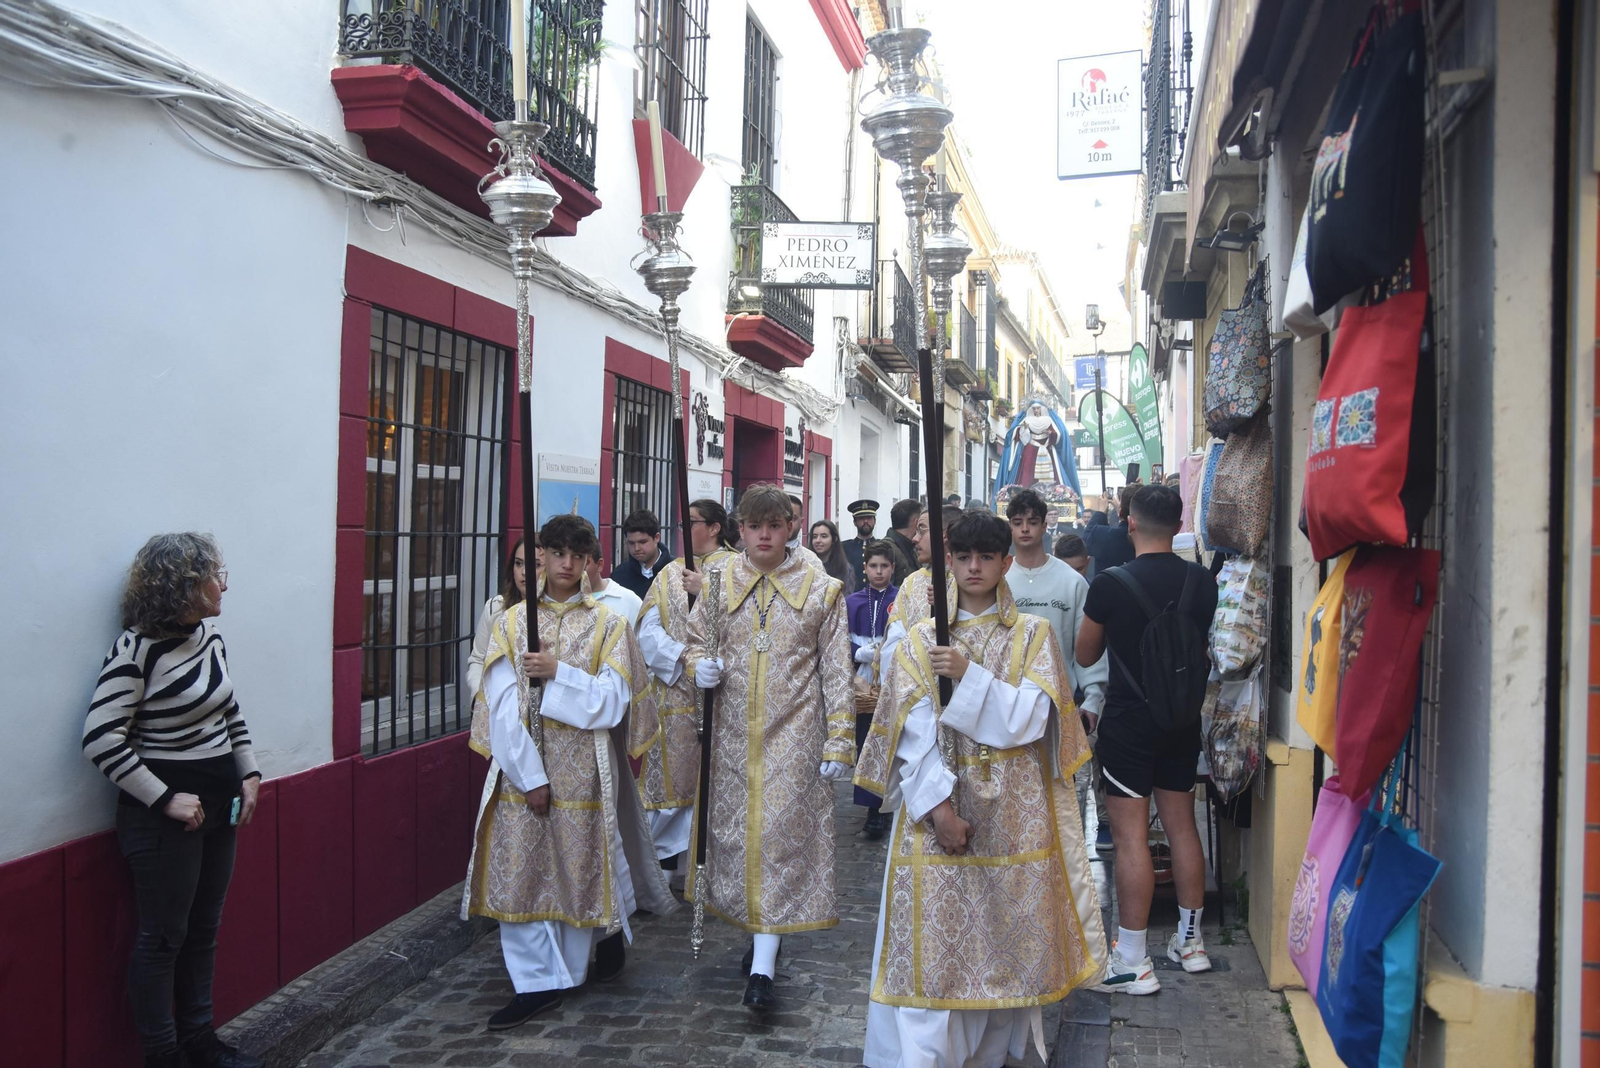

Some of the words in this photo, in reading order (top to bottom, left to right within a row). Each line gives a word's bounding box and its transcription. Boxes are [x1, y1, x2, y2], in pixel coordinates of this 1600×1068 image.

[1072, 86, 1130, 112] Rafaé
[1066, 109, 1086, 118] 1977
[1087, 151, 1100, 162] 10
[1101, 151, 1112, 161] m
[787, 237, 848, 253] PEDRO
[778, 253, 857, 269] XIMÉNEZ
[1114, 444, 1141, 458] NUEVO
[1117, 452, 1144, 466] SUPER
[545, 462, 560, 472] VISITA
[560, 464, 579, 474] NUESTRA
[1015, 597, 1048, 608] Dinner
